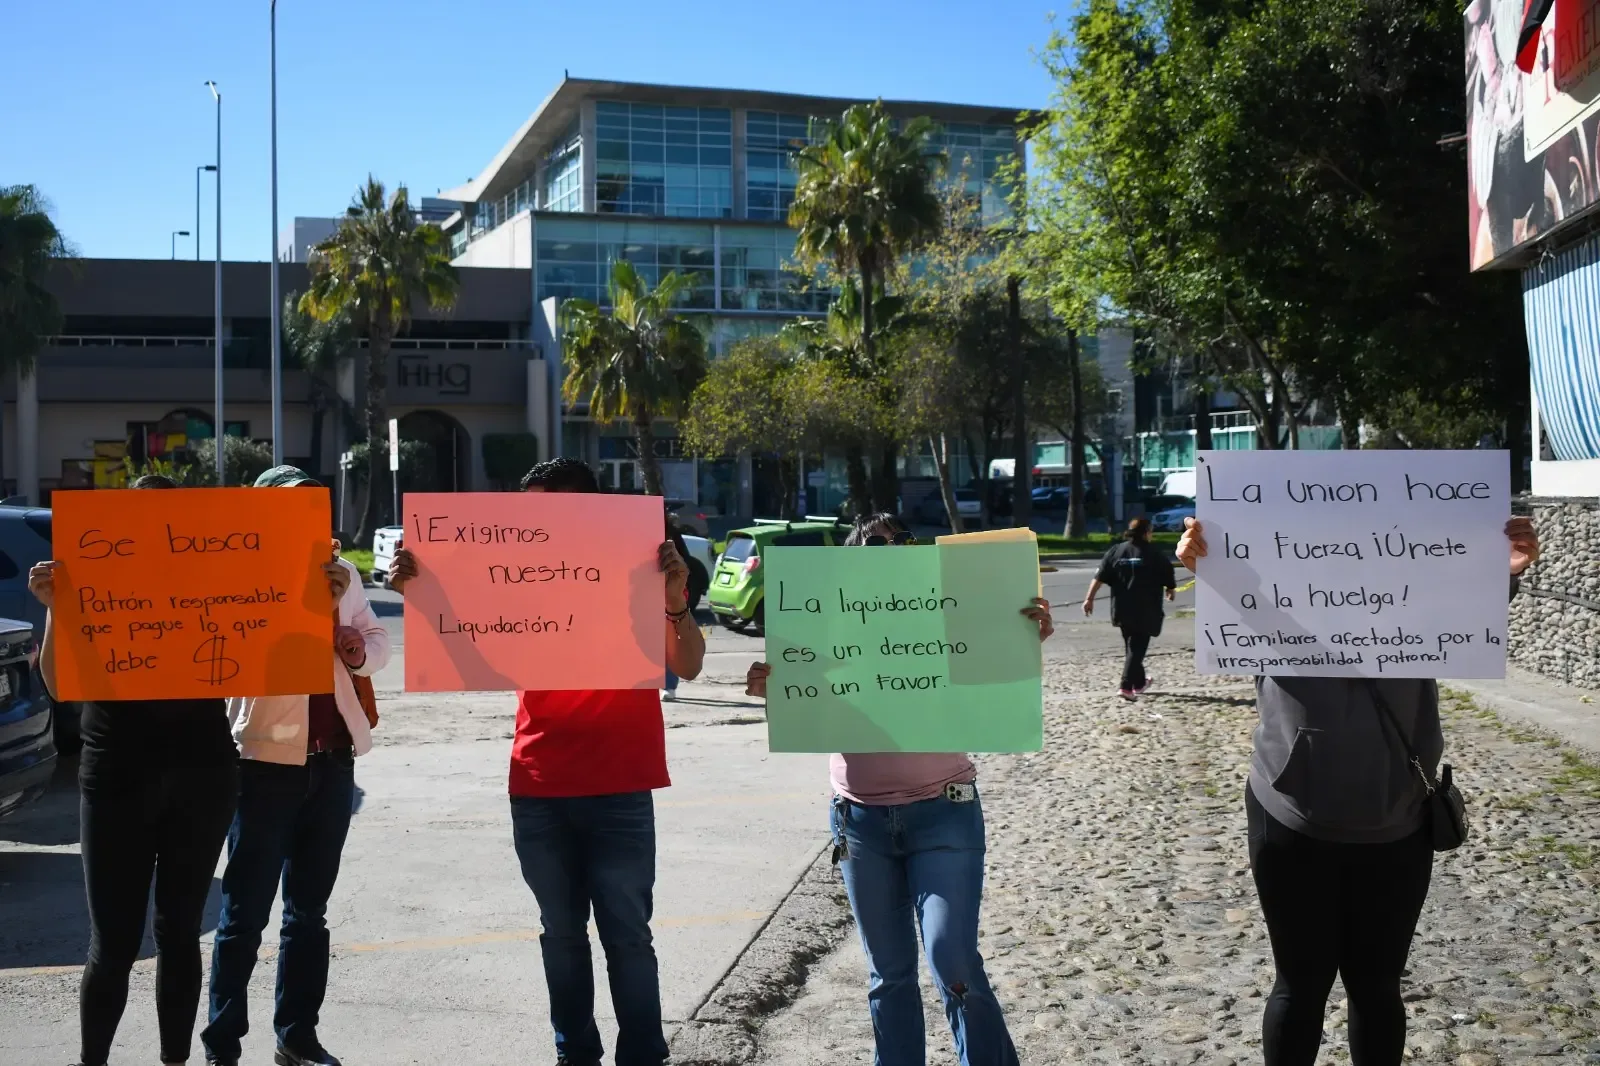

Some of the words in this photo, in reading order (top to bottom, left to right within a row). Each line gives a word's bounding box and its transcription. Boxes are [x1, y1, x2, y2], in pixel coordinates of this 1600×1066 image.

[1206, 464, 1262, 504] La
[1404, 473, 1491, 501] hace
[78, 529, 136, 560] Se
[166, 523, 261, 554] busca
[412, 513, 550, 545] ¡Exigimos
[1224, 532, 1250, 560] la
[1371, 524, 1467, 560] ¡Únete
[488, 560, 601, 585] nuestra
[78, 585, 153, 614] Patrón
[169, 585, 288, 617] responsable
[778, 580, 822, 614] La
[838, 587, 958, 625] liquidación
[1240, 593, 1257, 610] a
[1272, 583, 1293, 609] la
[1308, 583, 1409, 615] huelga!
[81, 623, 113, 643] que
[127, 620, 184, 641] pague
[199, 612, 219, 636] lo
[232, 618, 269, 641] que
[1204, 623, 1317, 648] ¡Familiares
[1330, 626, 1424, 647] afectados
[1436, 632, 1475, 654] por
[1485, 627, 1501, 646] la
[104, 647, 158, 674] debe
[782, 647, 817, 663] es
[833, 645, 862, 660] un
[879, 636, 968, 656] derecho
[1216, 650, 1364, 673] irresponsabilidad
[1375, 651, 1447, 673] patrona!
[784, 684, 819, 700] no
[830, 681, 860, 696] un
